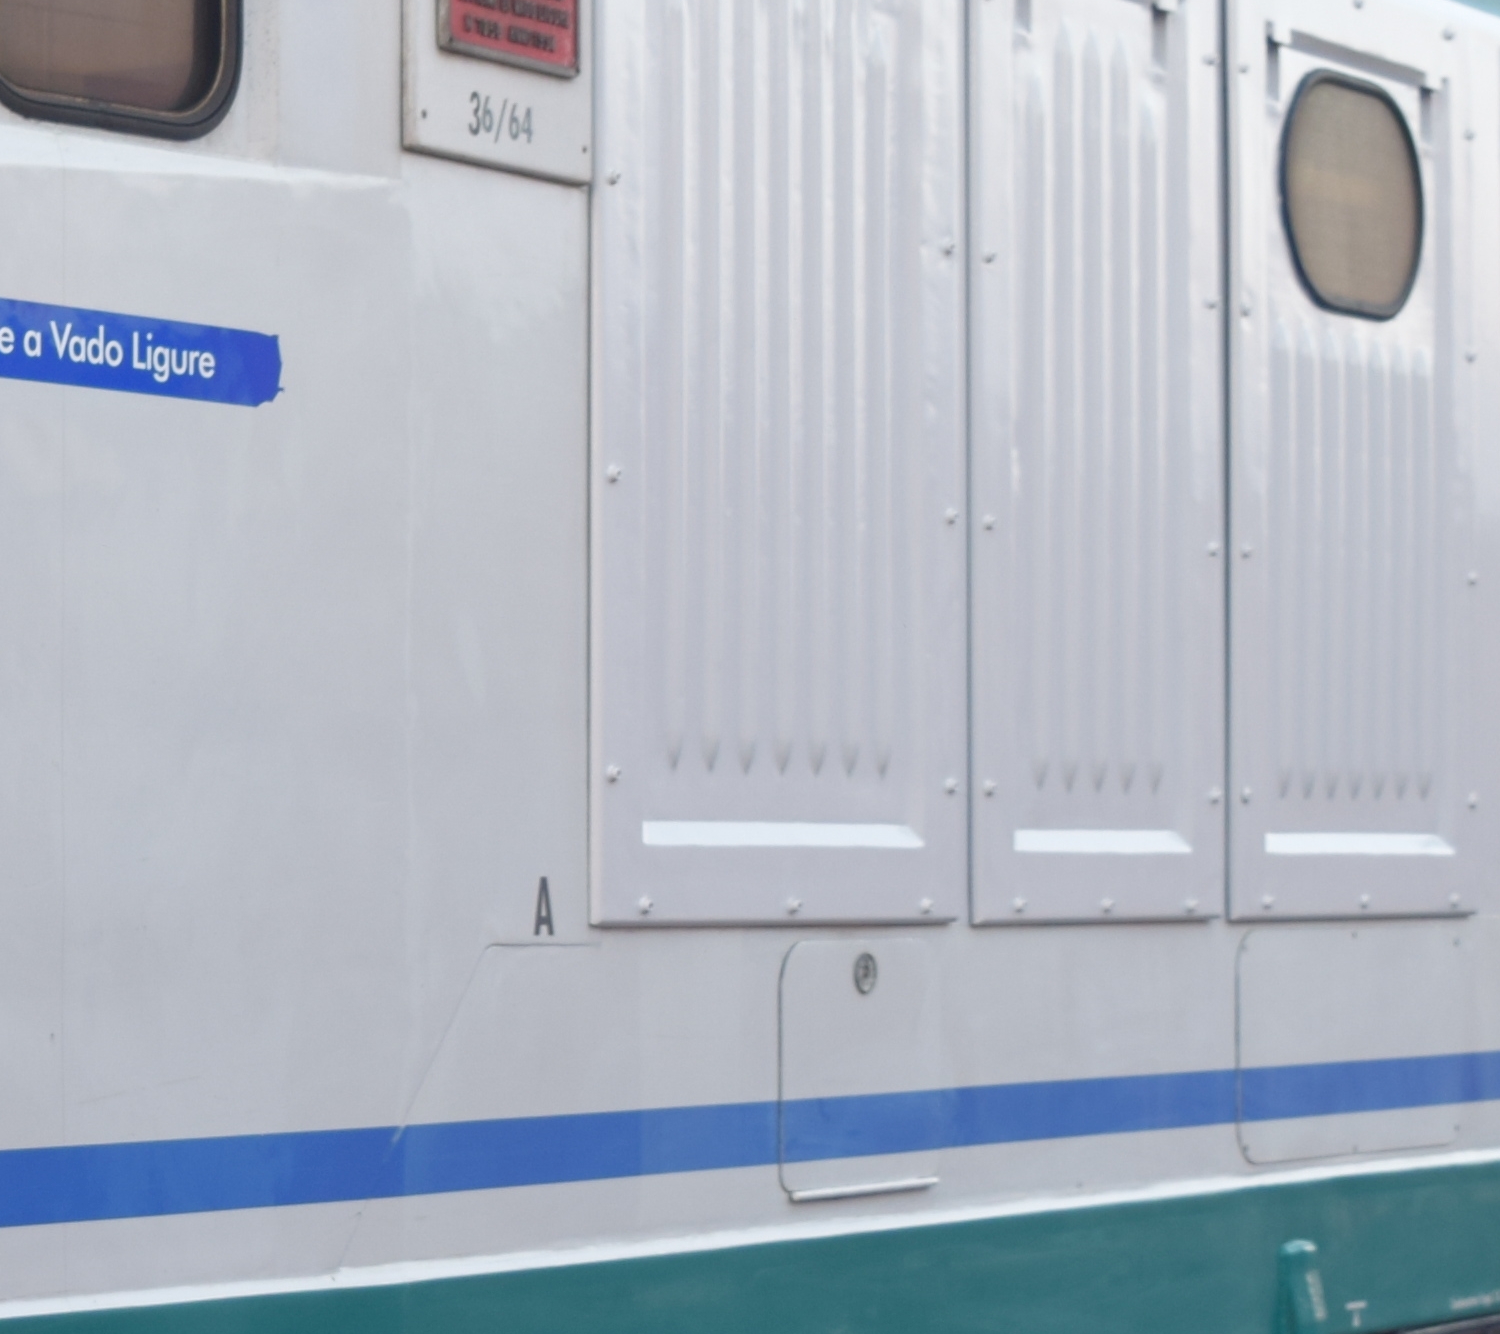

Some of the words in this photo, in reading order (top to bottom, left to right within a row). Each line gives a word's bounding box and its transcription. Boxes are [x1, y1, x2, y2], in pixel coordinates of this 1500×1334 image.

[468, 90, 534, 144] 36/64
[21, 334, 43, 360] a
[49, 322, 124, 369] Vado
[130, 331, 218, 383] Ligure
[532, 875, 556, 937] A
